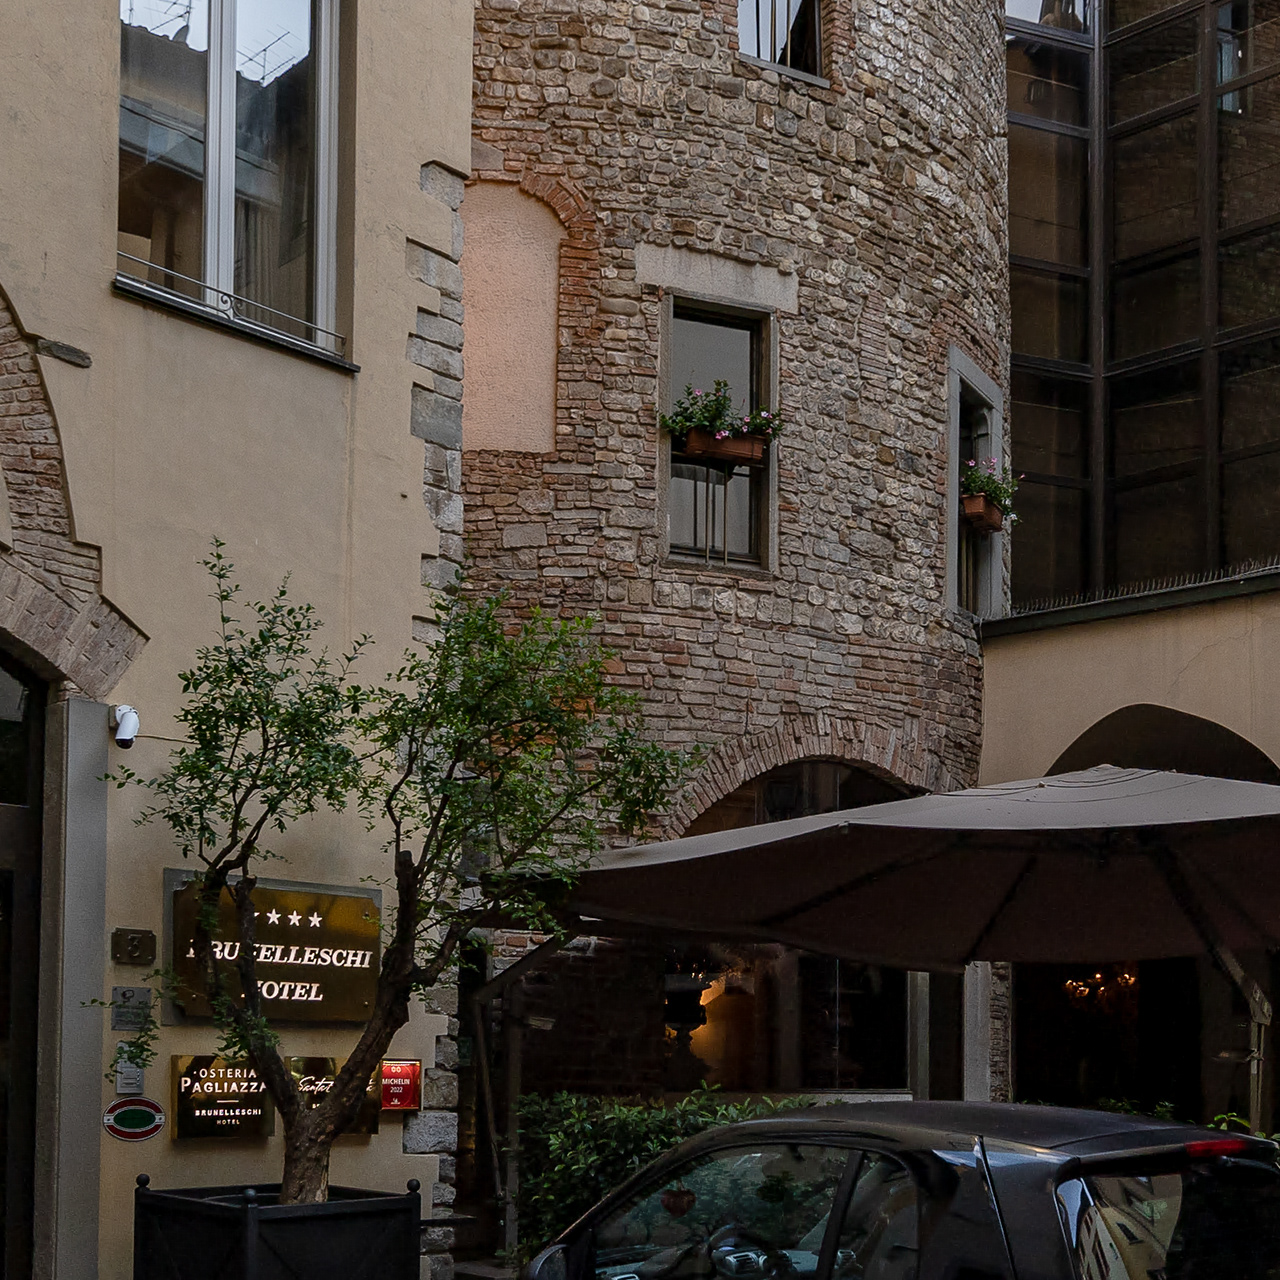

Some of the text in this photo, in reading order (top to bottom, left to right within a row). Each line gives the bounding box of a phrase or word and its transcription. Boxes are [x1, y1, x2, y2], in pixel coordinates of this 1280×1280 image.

[128, 934, 143, 958] 3
[186, 939, 374, 969] RUELLESCHI
[241, 981, 324, 1002] OTEL
[199, 1068, 257, 1079] OSTERIA
[194, 1108, 262, 1117] BRUNELLESCHI
